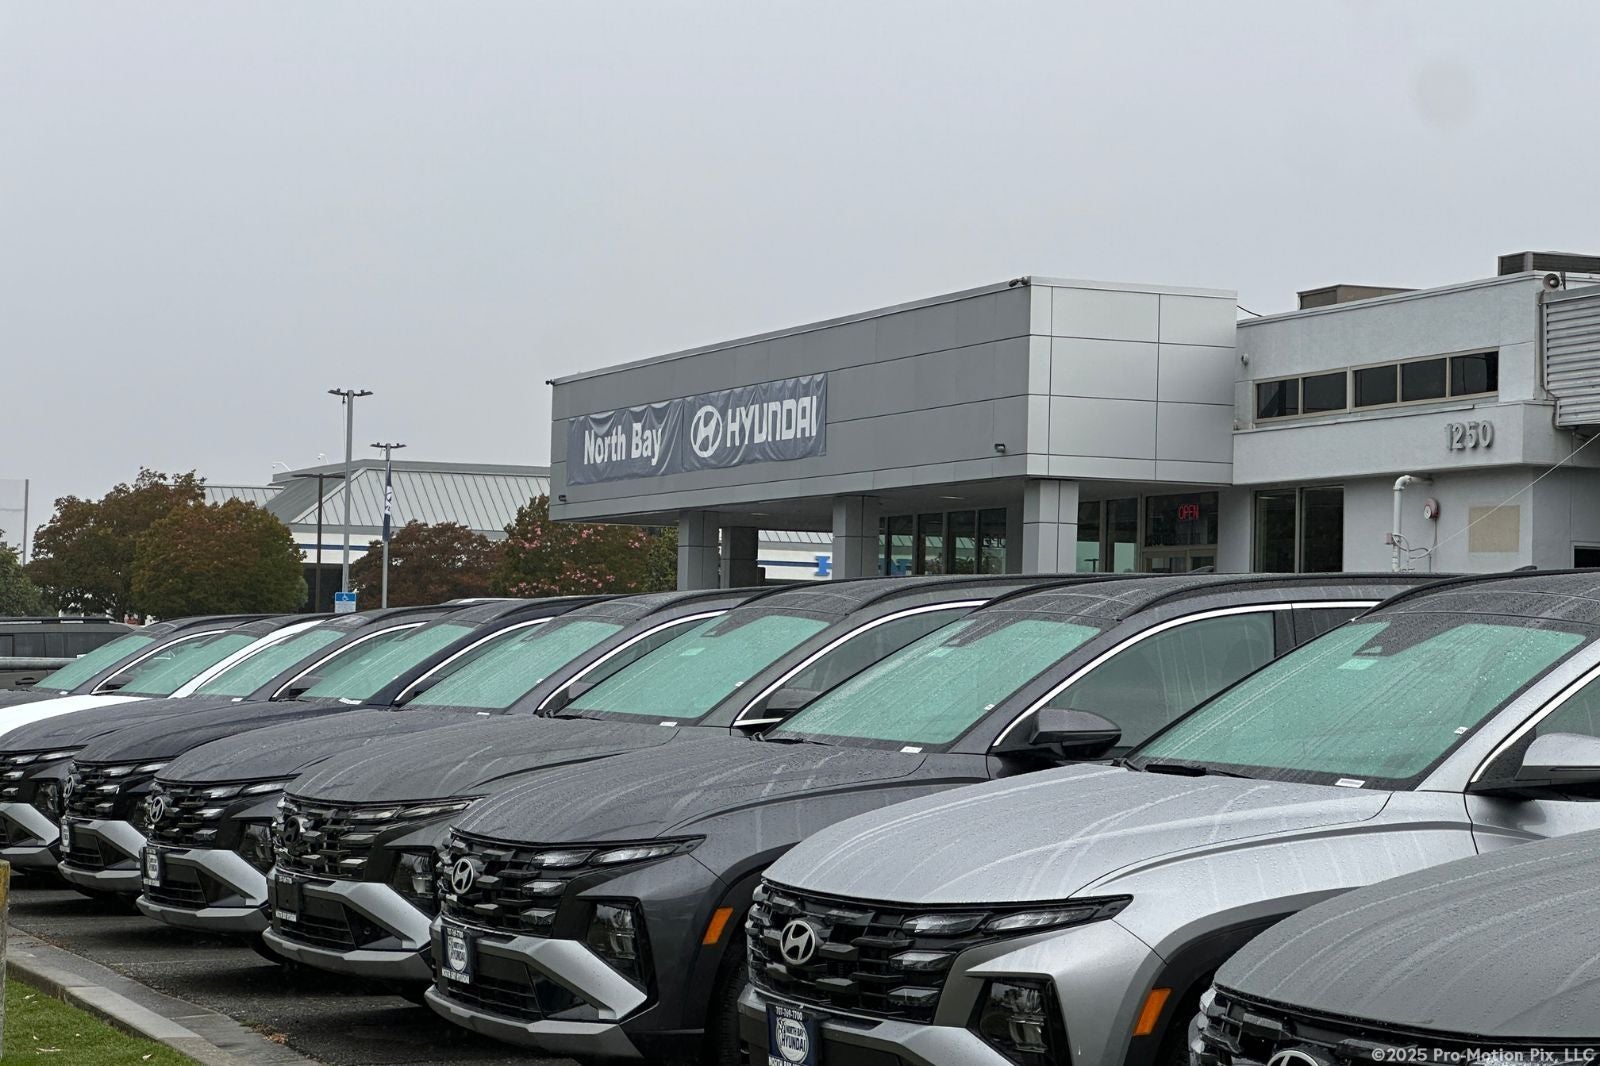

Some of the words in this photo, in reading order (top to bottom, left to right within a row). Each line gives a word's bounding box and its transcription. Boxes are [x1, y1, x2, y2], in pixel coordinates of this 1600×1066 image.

[726, 395, 817, 448] HYUNDAI
[1447, 421, 1493, 450] 1250
[584, 423, 626, 465] North
[631, 422, 661, 467] Bay
[1177, 503, 1201, 520] OPEN
[781, 1036, 806, 1052] HYUNDAI
